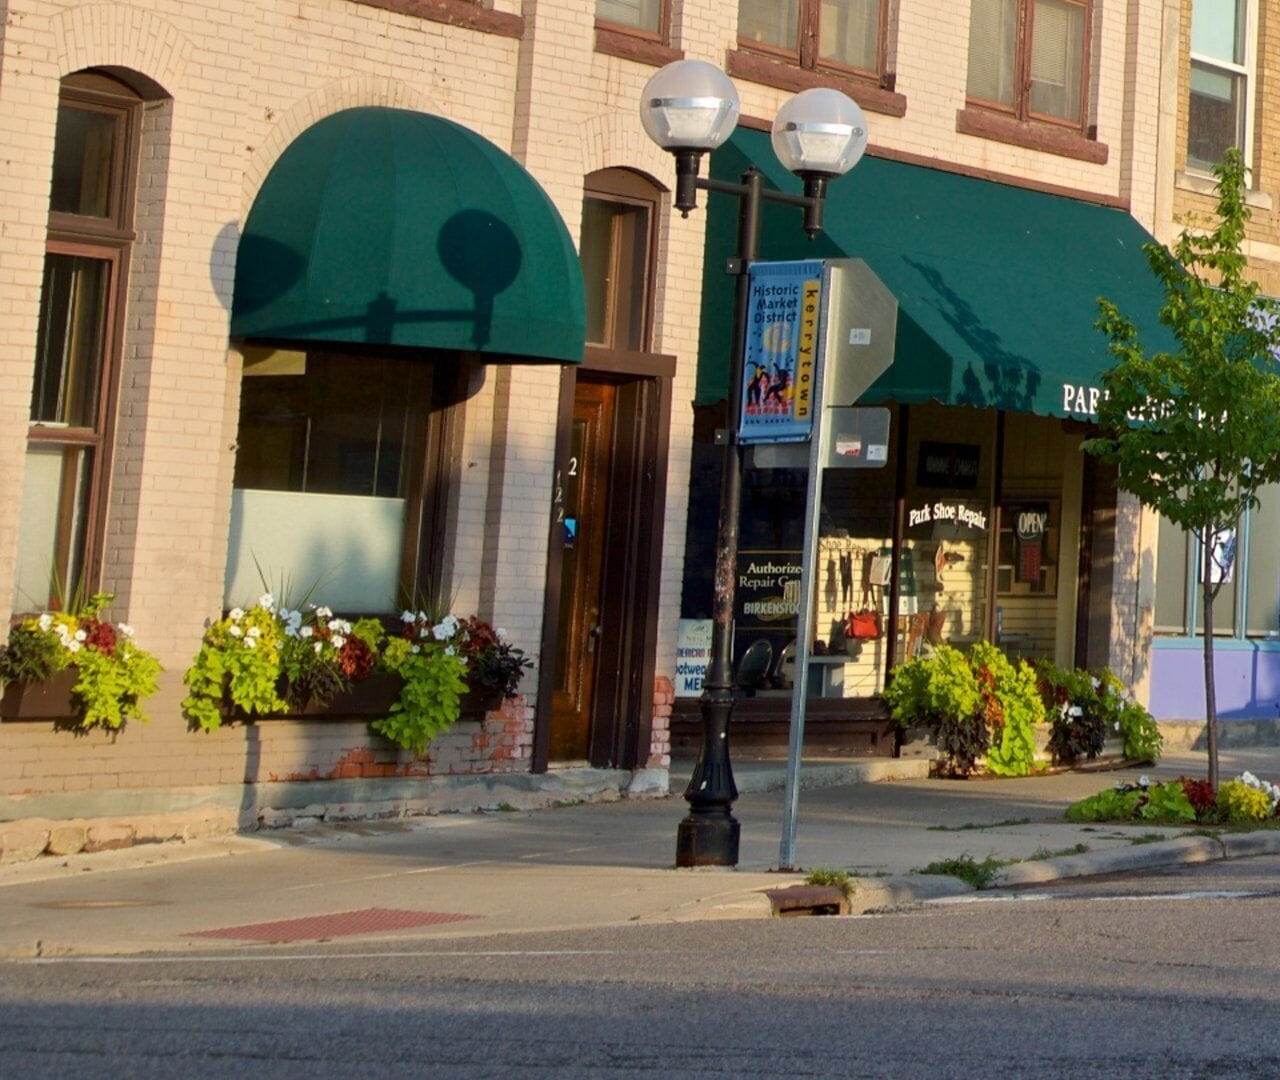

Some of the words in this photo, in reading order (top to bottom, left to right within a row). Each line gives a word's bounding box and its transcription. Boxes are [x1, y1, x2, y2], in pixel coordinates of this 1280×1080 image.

[753, 283, 799, 297] Historic
[756, 299, 798, 311] Market
[754, 311, 798, 324] District
[799, 289, 819, 416] kerrytown
[908, 503, 931, 527] Park
[933, 502, 957, 520] Shoe
[958, 504, 987, 530] Repair
[1018, 512, 1046, 533] OPEN
[747, 562, 803, 574] Authorize
[739, 576, 775, 591] Repair
[744, 601, 801, 615] BIRKENSTOC
